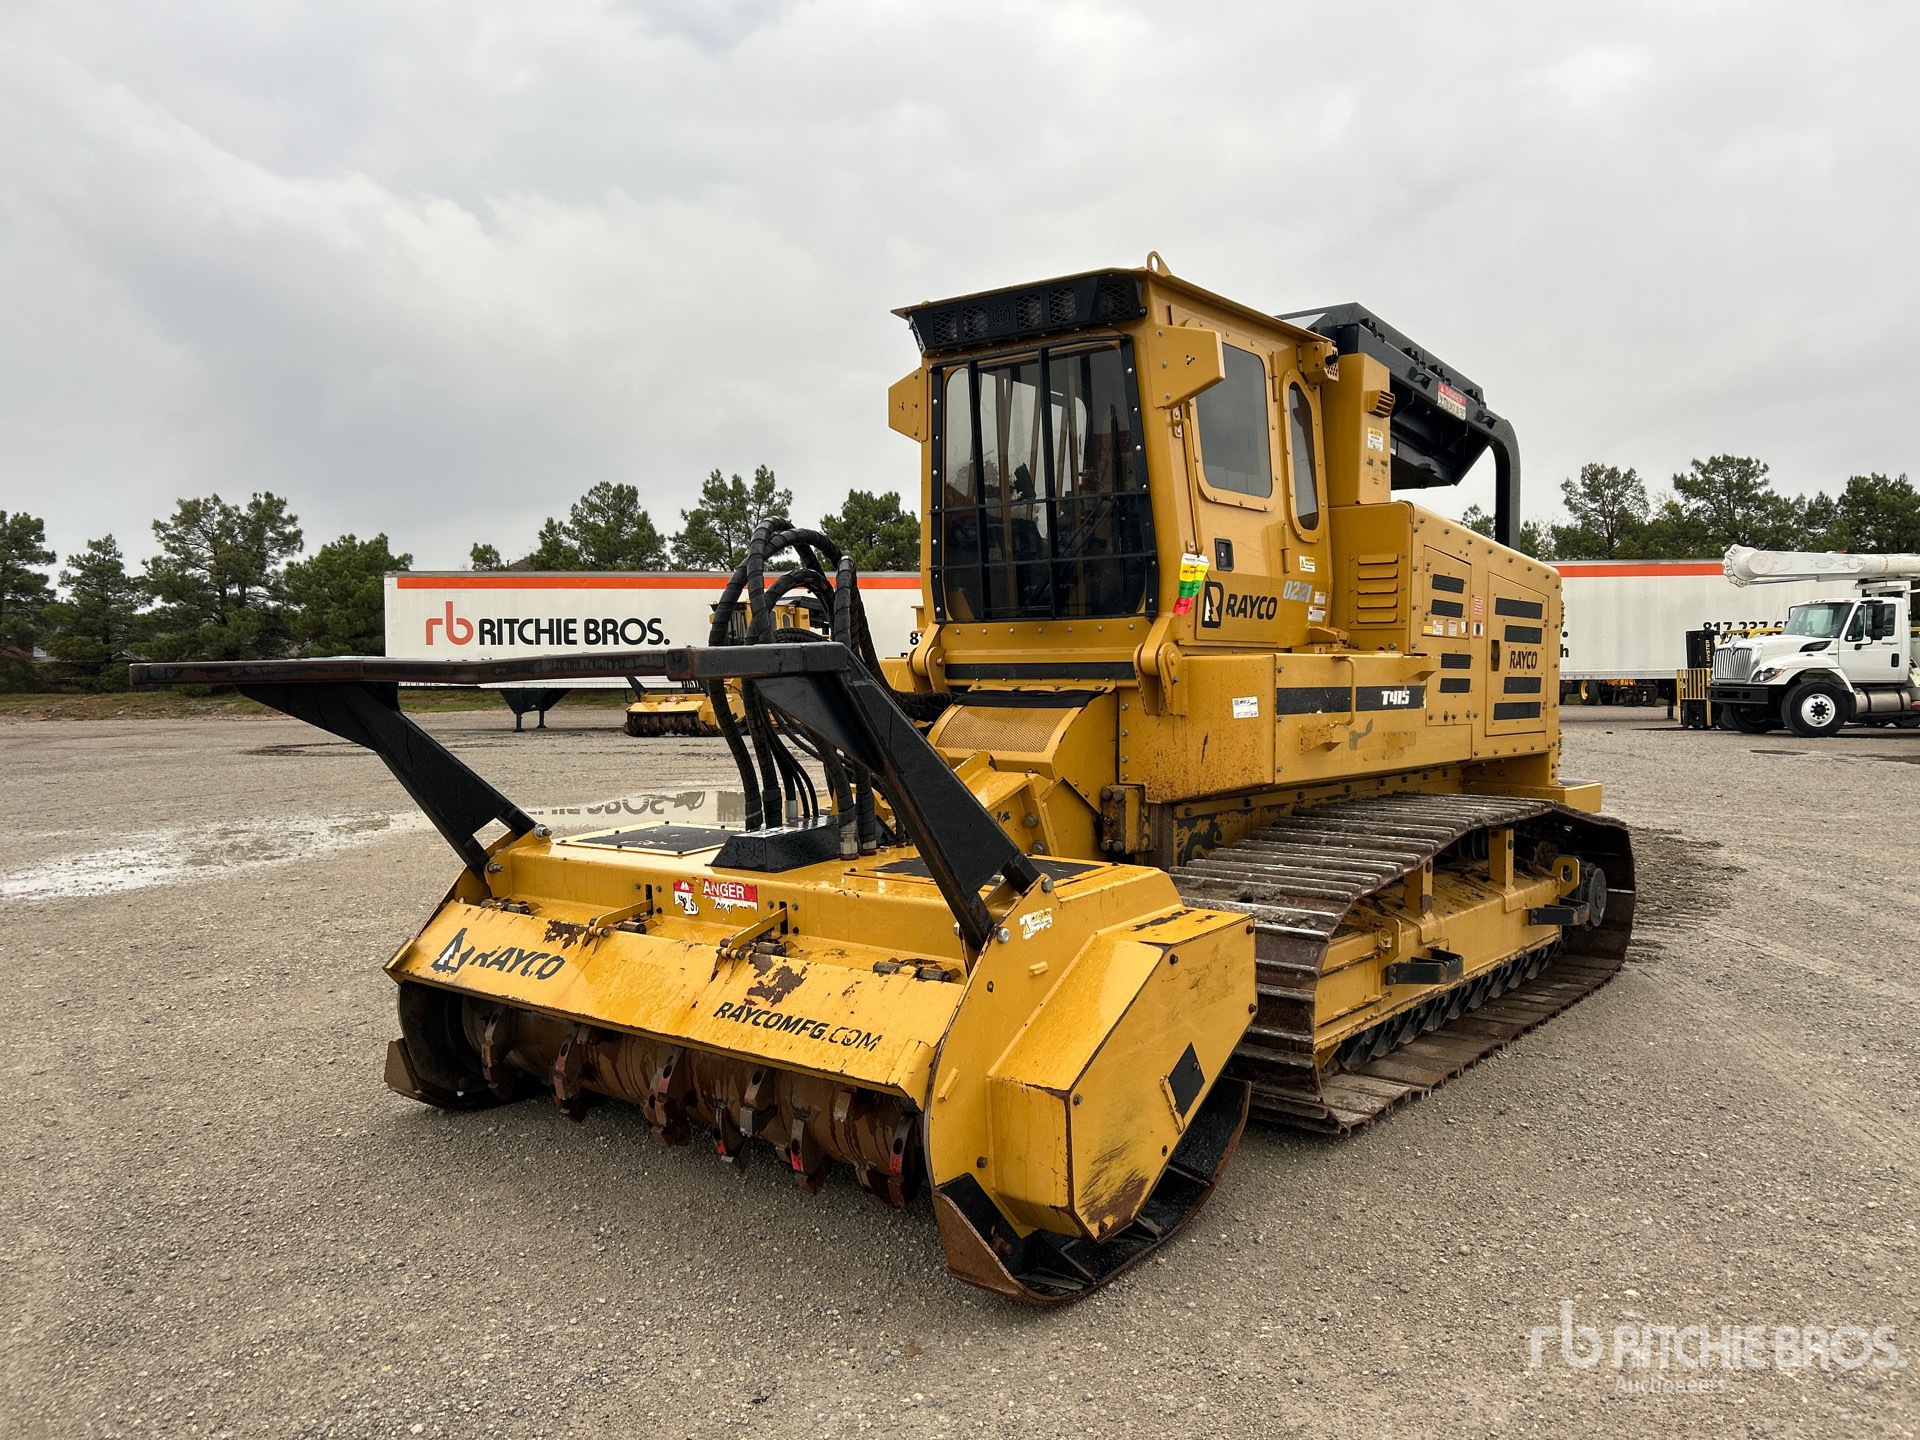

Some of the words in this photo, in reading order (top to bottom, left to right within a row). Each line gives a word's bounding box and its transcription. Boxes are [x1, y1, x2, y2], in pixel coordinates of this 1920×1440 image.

[1282, 580, 1313, 604] 0221
[1226, 593, 1278, 620] RAYCO
[425, 600, 475, 646] rb
[478, 618, 578, 646] RITCHIE
[583, 618, 671, 646] BROS.
[1509, 650, 1538, 670] RAYCO
[702, 880, 745, 899] ANGER
[712, 1001, 884, 1053] RAYCOMFG.COM
